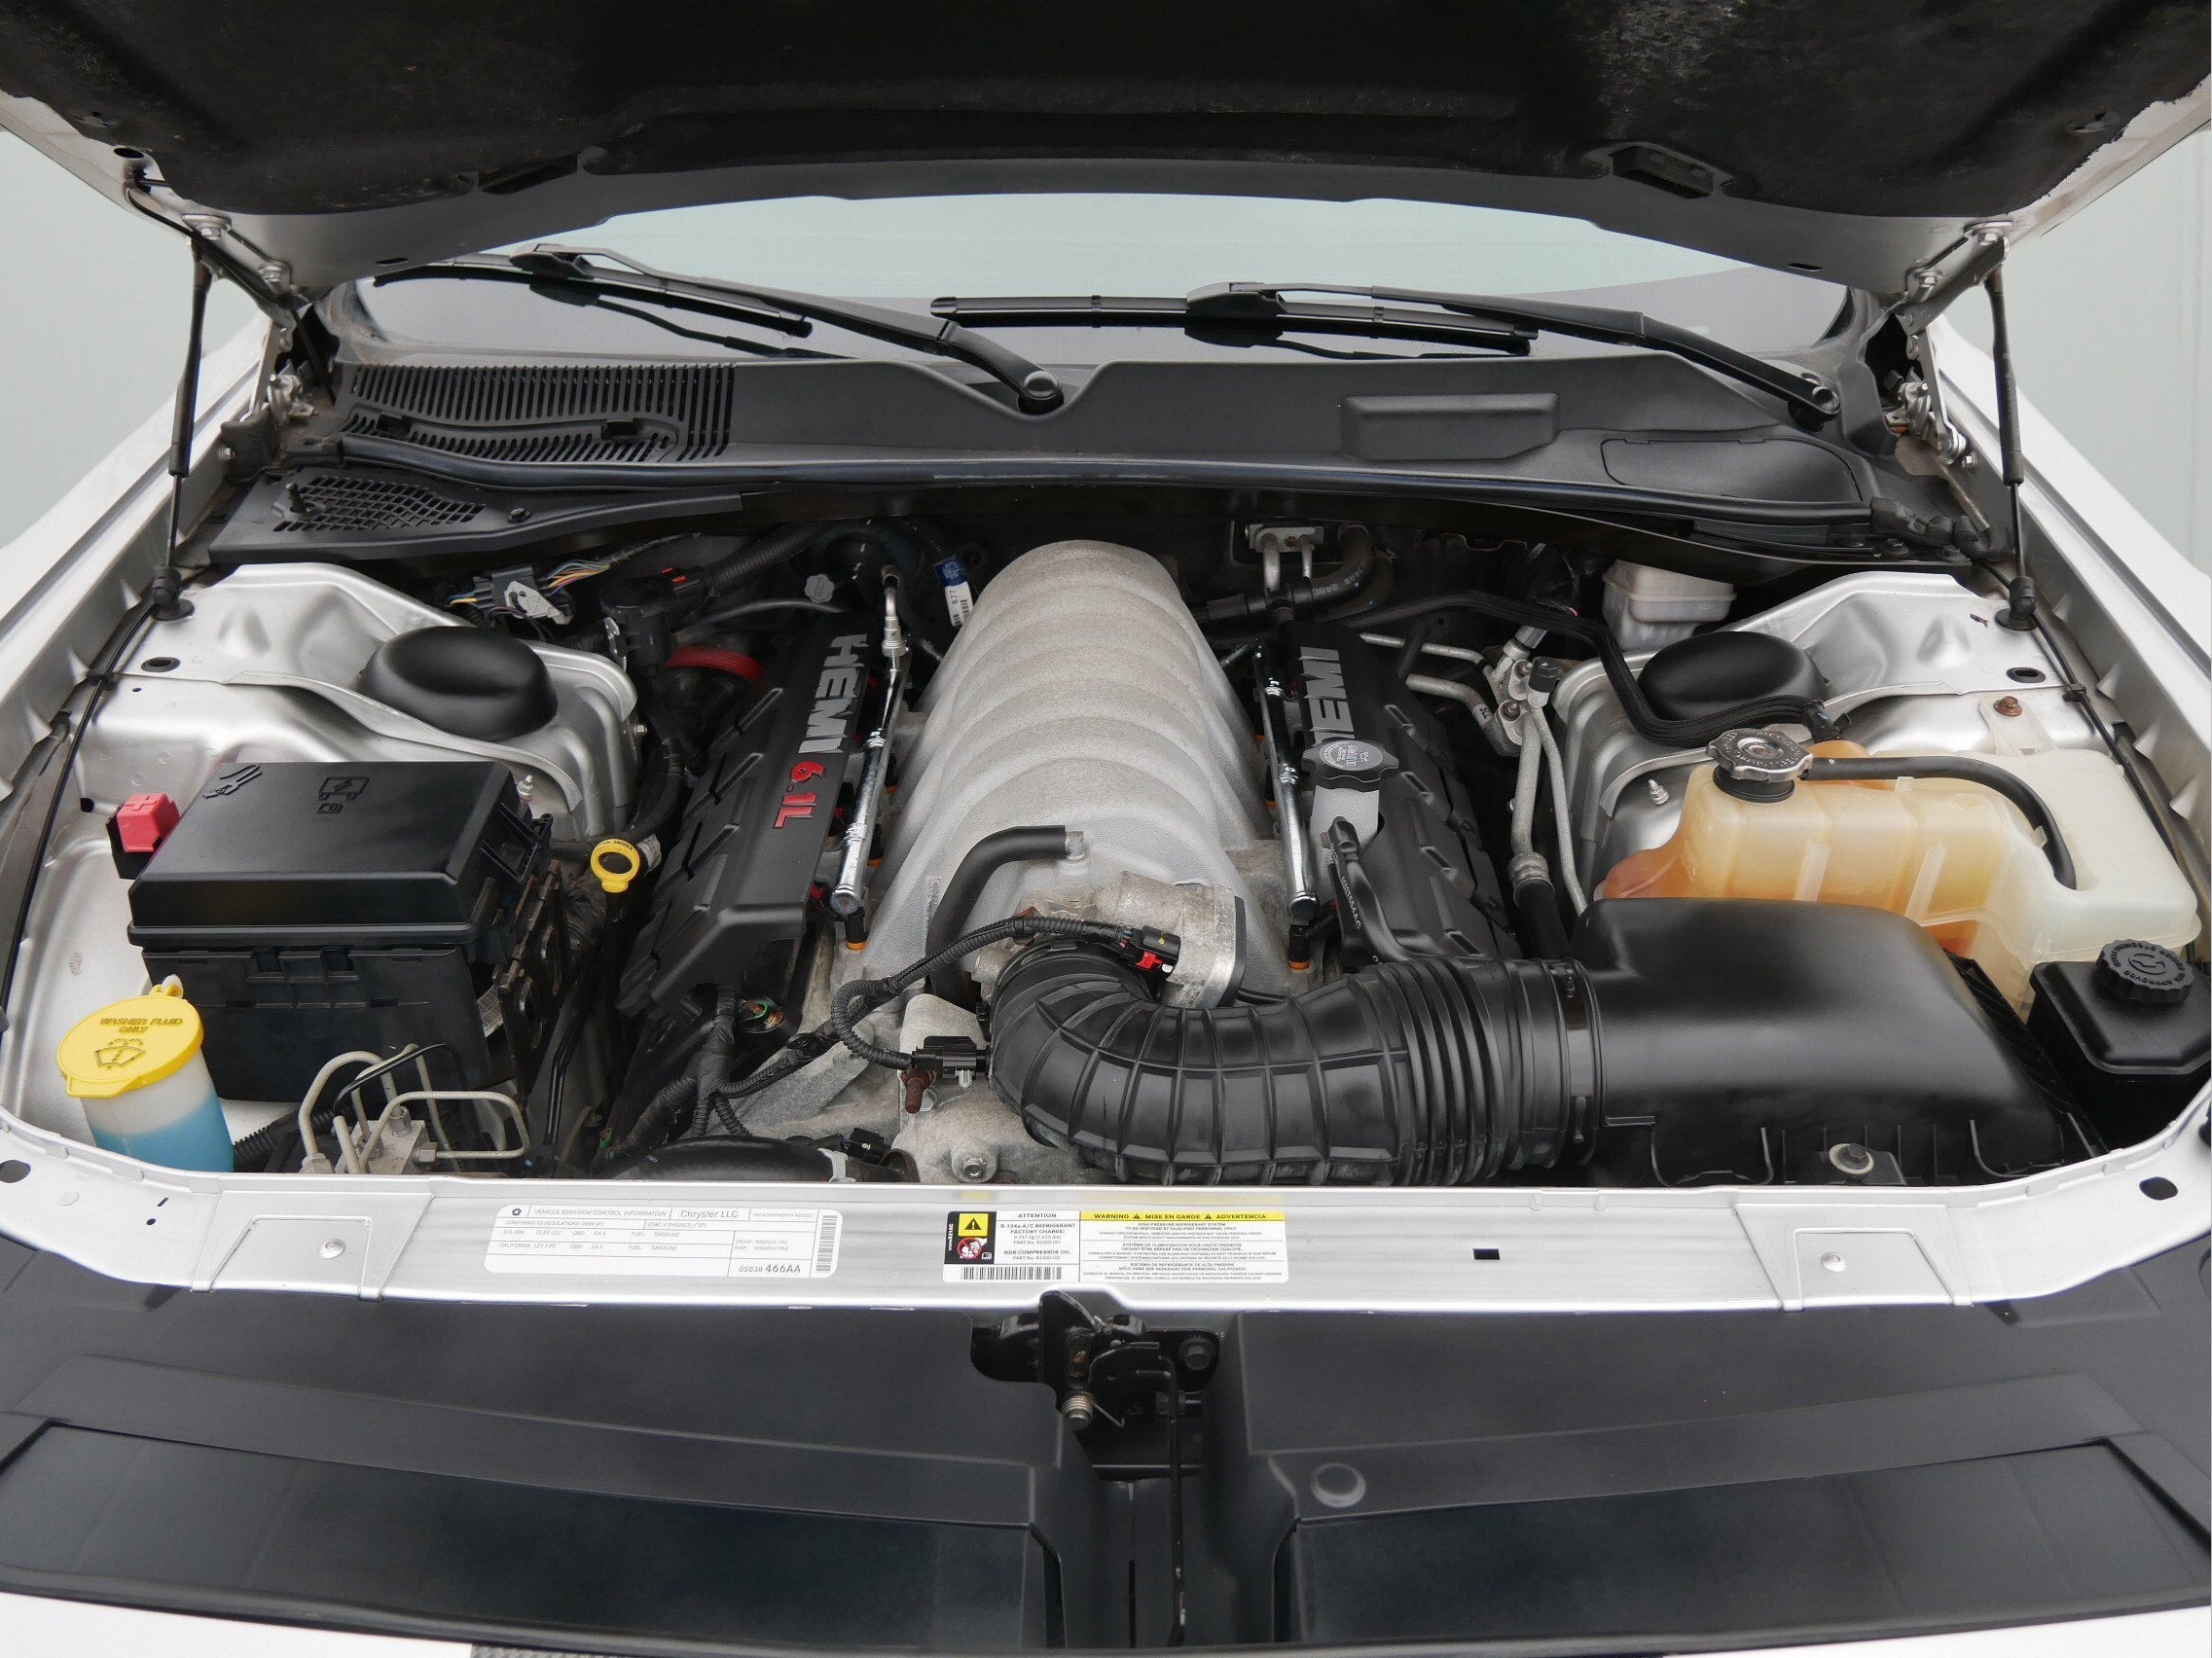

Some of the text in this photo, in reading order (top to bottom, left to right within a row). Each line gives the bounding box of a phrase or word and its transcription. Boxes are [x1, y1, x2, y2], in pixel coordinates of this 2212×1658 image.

[798, 632, 870, 754] HEMI
[774, 760, 825, 829] 6.1L
[100, 1017, 148, 1025] WASHER
[681, 1209, 719, 1220] Chrysler
[764, 1264, 801, 1273] 466AA
